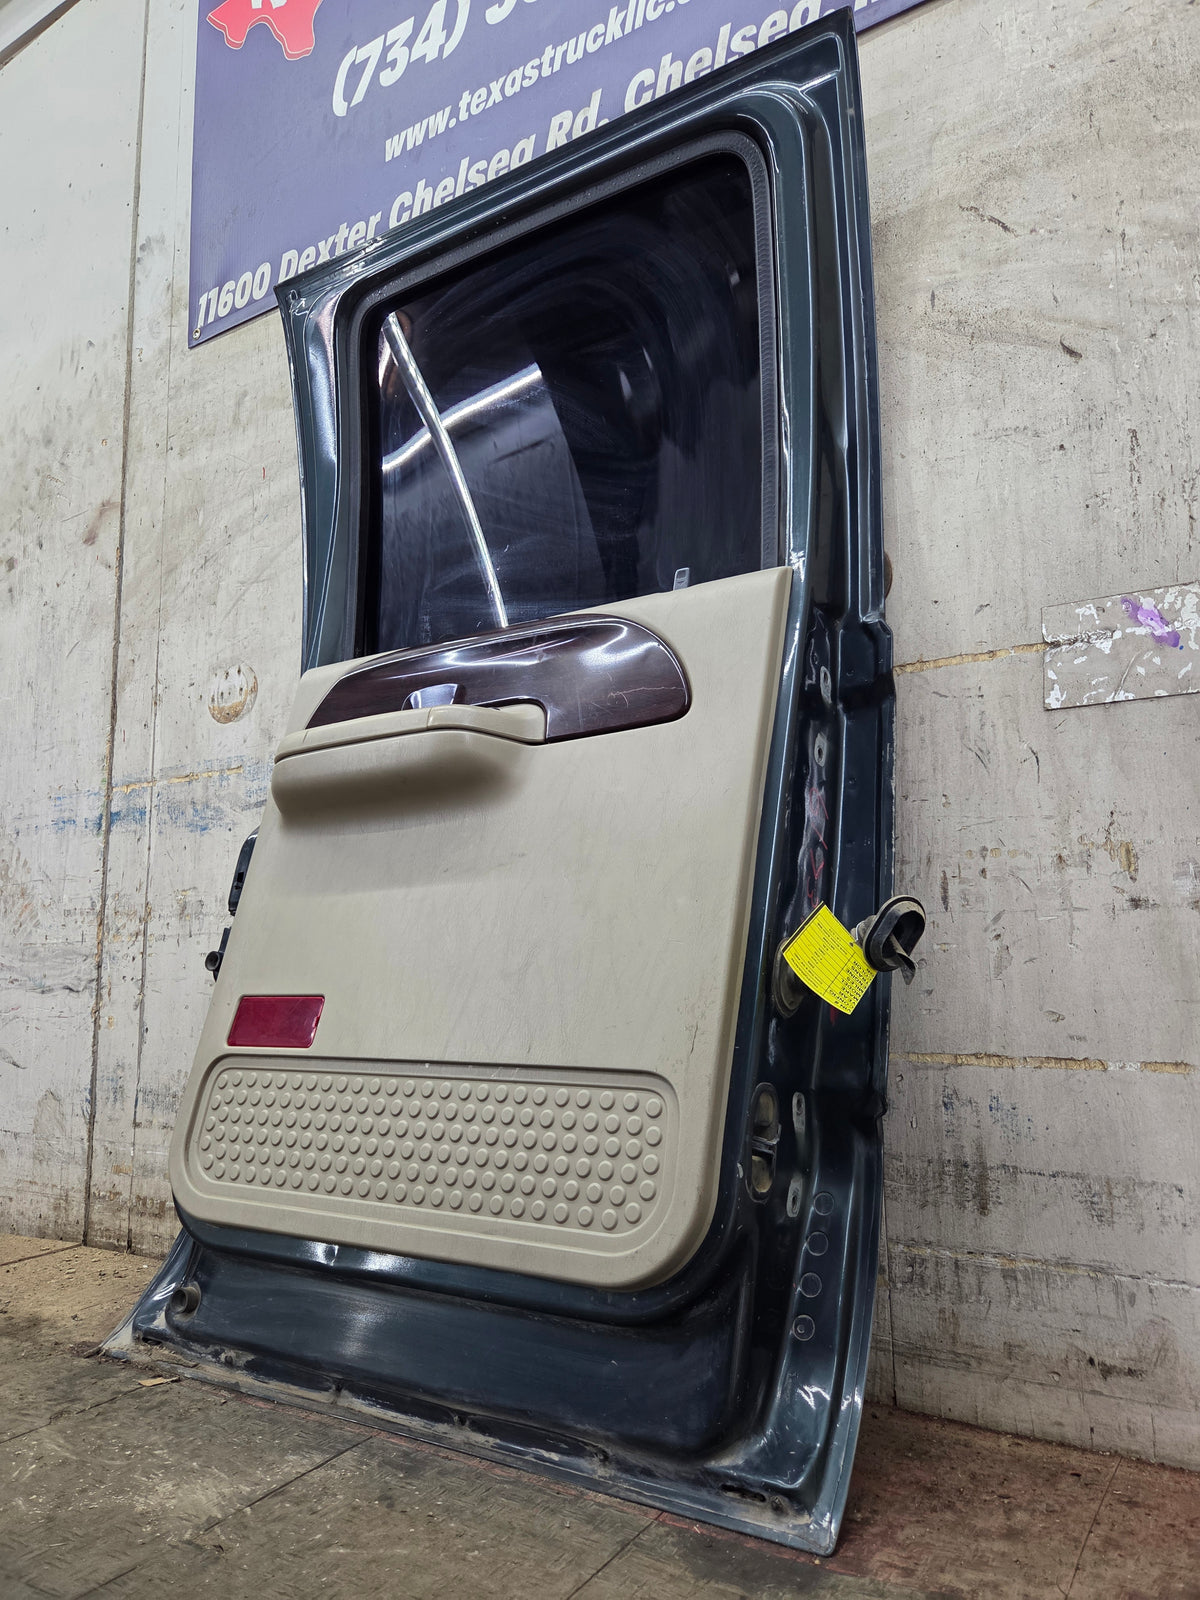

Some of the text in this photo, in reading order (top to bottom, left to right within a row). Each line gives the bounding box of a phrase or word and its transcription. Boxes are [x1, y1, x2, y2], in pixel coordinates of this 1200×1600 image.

[332, 0, 470, 117] (734)
[384, 0, 693, 163] www.texastruckllc.
[197, 262, 272, 330] 11600
[278, 211, 382, 284] Dexter
[387, 133, 537, 231] Chelsea
